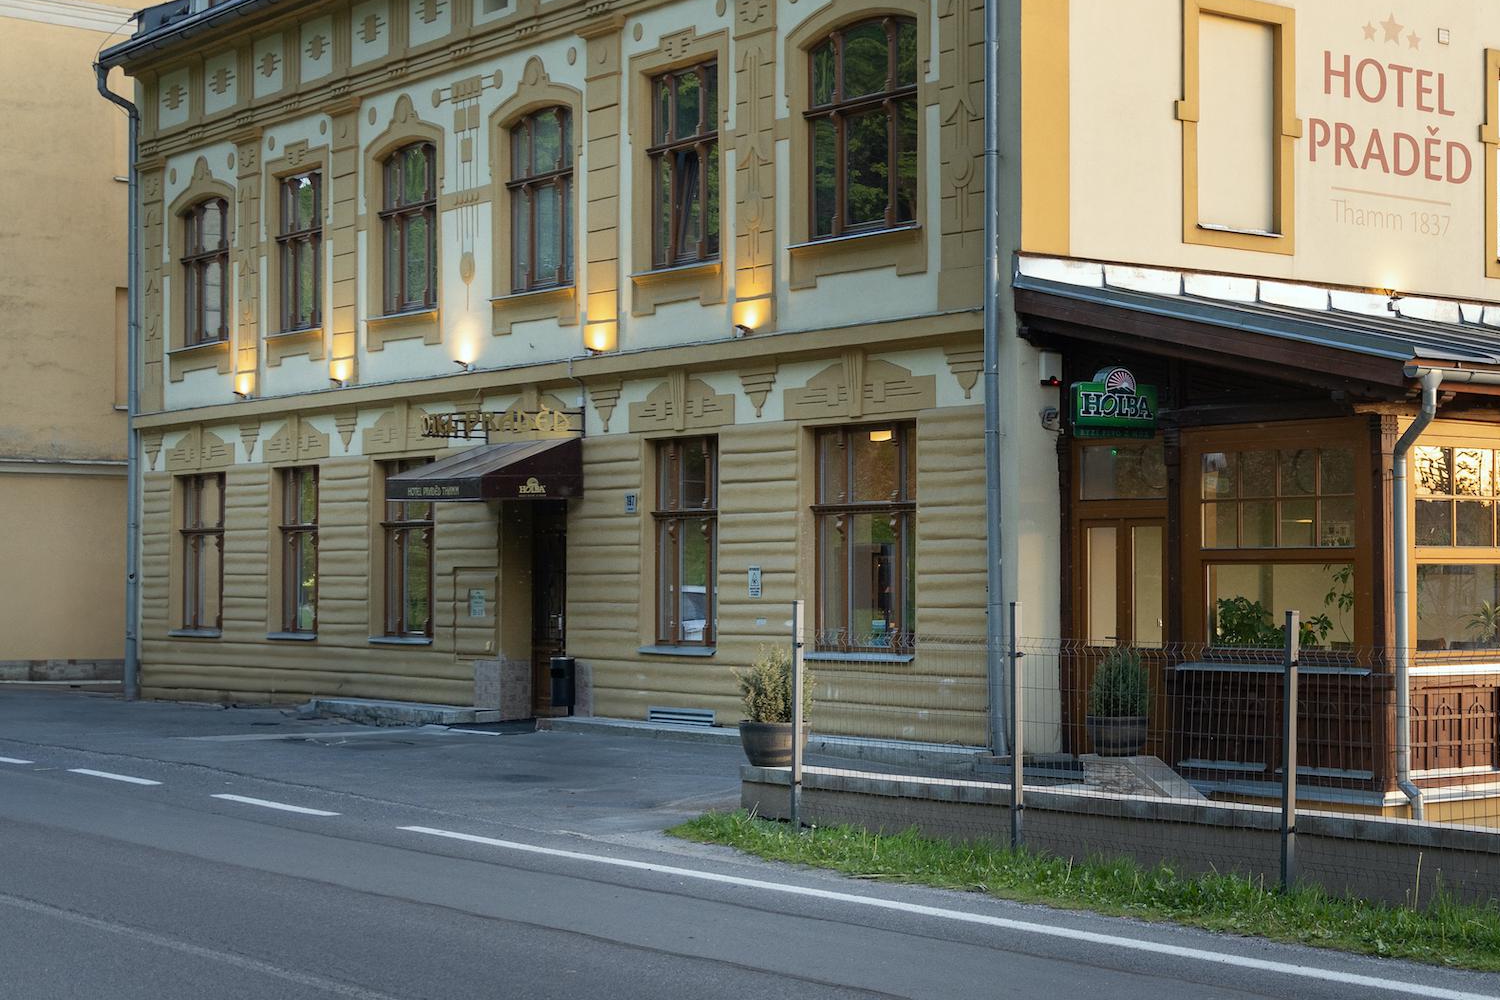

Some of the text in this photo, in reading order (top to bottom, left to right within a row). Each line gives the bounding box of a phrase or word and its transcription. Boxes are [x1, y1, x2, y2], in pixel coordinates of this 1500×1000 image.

[1323, 50, 1455, 117] HOTEL
[1308, 117, 1472, 185] PRADĚD
[1331, 198, 1450, 236] Thamm 1837
[1080, 391, 1153, 420] HOLBA
